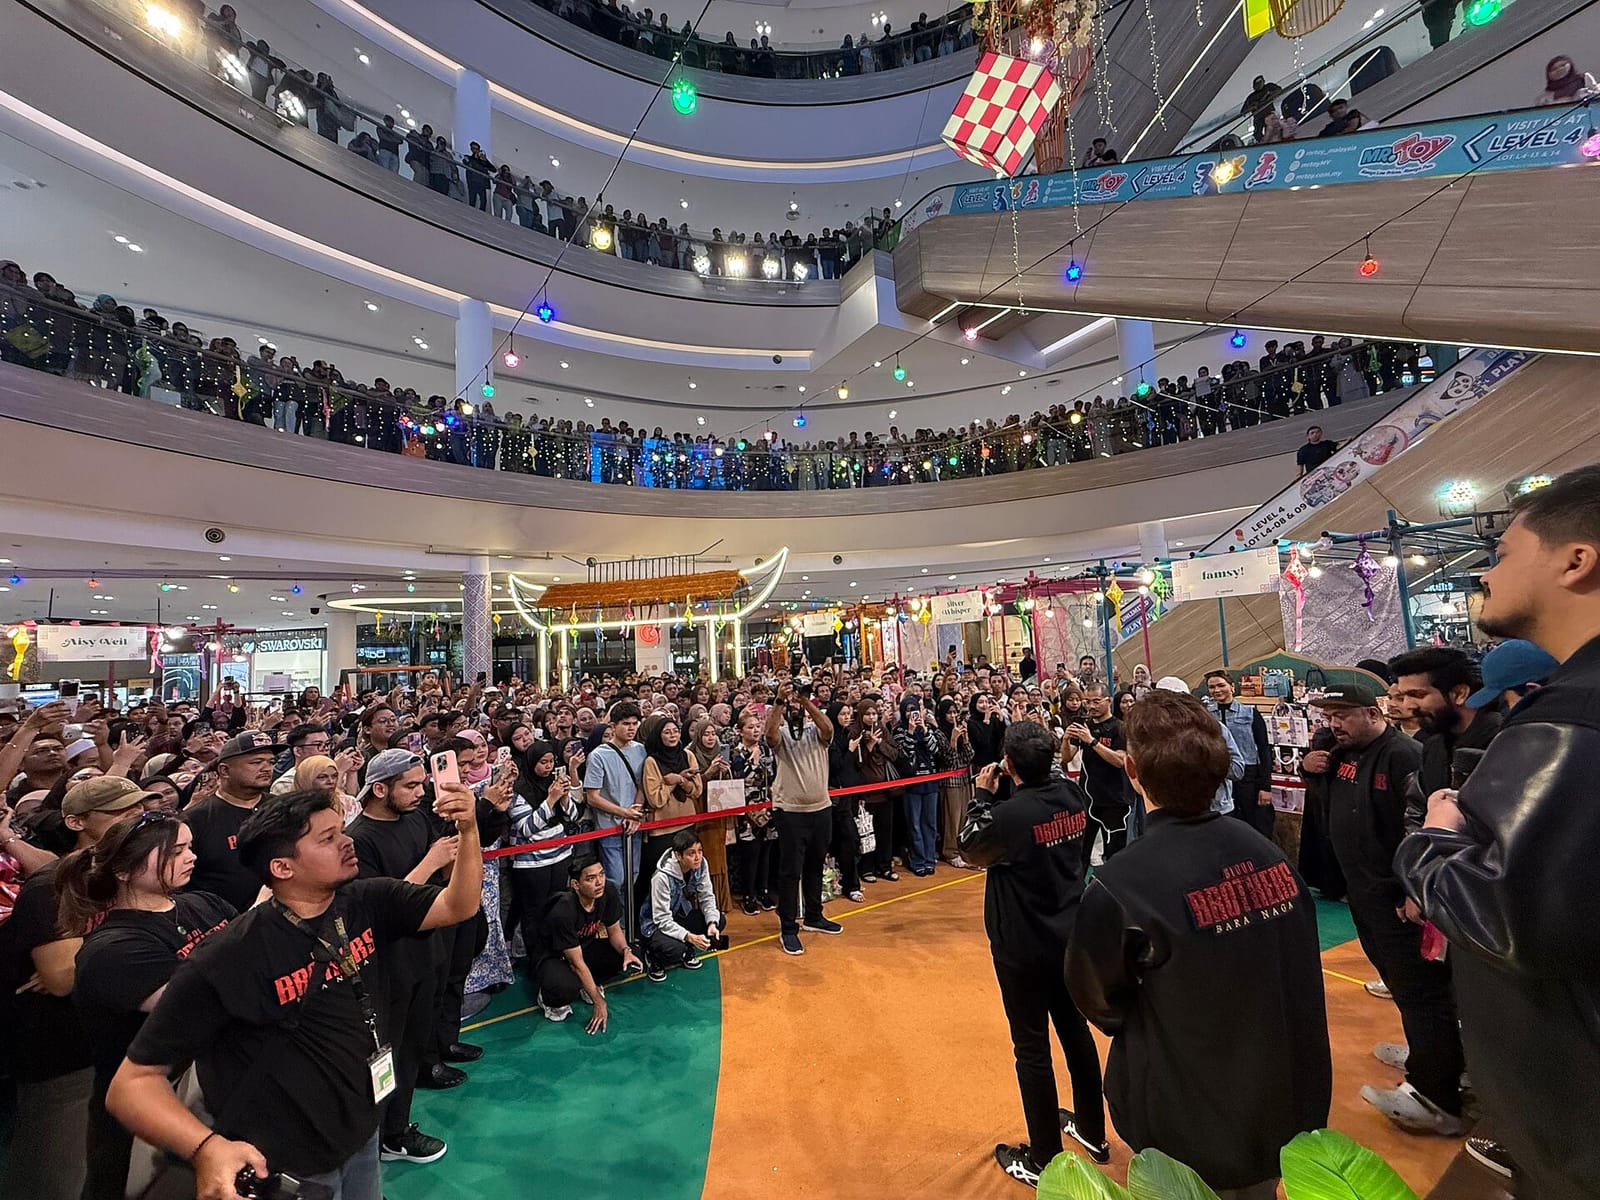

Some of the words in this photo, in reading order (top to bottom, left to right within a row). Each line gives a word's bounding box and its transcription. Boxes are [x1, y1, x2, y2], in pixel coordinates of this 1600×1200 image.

[1507, 119, 1540, 131] VISIT
[1564, 113, 1586, 125] AT
[1487, 129, 1558, 153] LEVEL
[1562, 126, 1585, 144] 4
[1143, 171, 1175, 187] LEVEL
[1176, 170, 1187, 183] 4
[1244, 535, 1260, 548] LOT
[1260, 517, 1287, 538] L4-08
[1286, 512, 1295, 520] &
[1294, 503, 1307, 514] 09
[1251, 512, 1278, 532] LEVEL
[1278, 506, 1286, 514] 4
[1121, 600, 1149, 622] UNLIMITD
[61, 638, 96, 648] Aisy
[260, 638, 323, 651] SWAROVSKI
[1186, 861, 1300, 928] BROTHERS
[1215, 916, 1251, 934] BARA
[1260, 901, 1295, 920] NAGA
